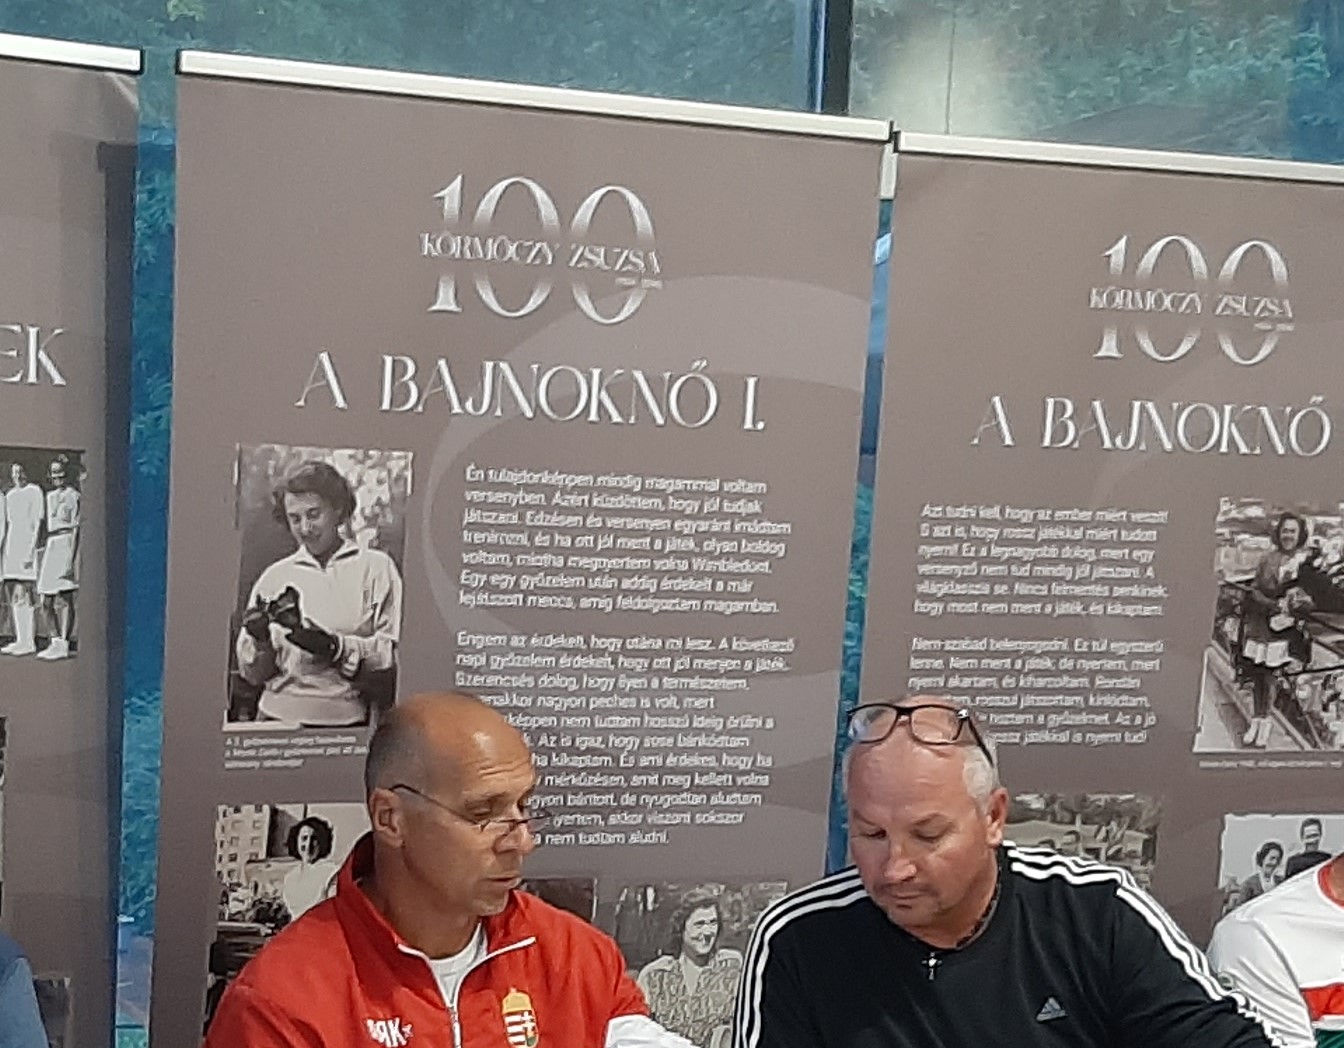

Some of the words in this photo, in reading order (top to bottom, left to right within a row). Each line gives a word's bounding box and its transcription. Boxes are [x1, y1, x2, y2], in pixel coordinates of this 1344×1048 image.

[427, 174, 655, 325] 100
[1093, 235, 1289, 365] 100
[295, 351, 347, 410] A
[381, 355, 719, 427] BAJNOKNŐ
[743, 375, 767, 430] I.
[971, 395, 1015, 447] A
[1041, 395, 1332, 458] BAJNOKNŐ
